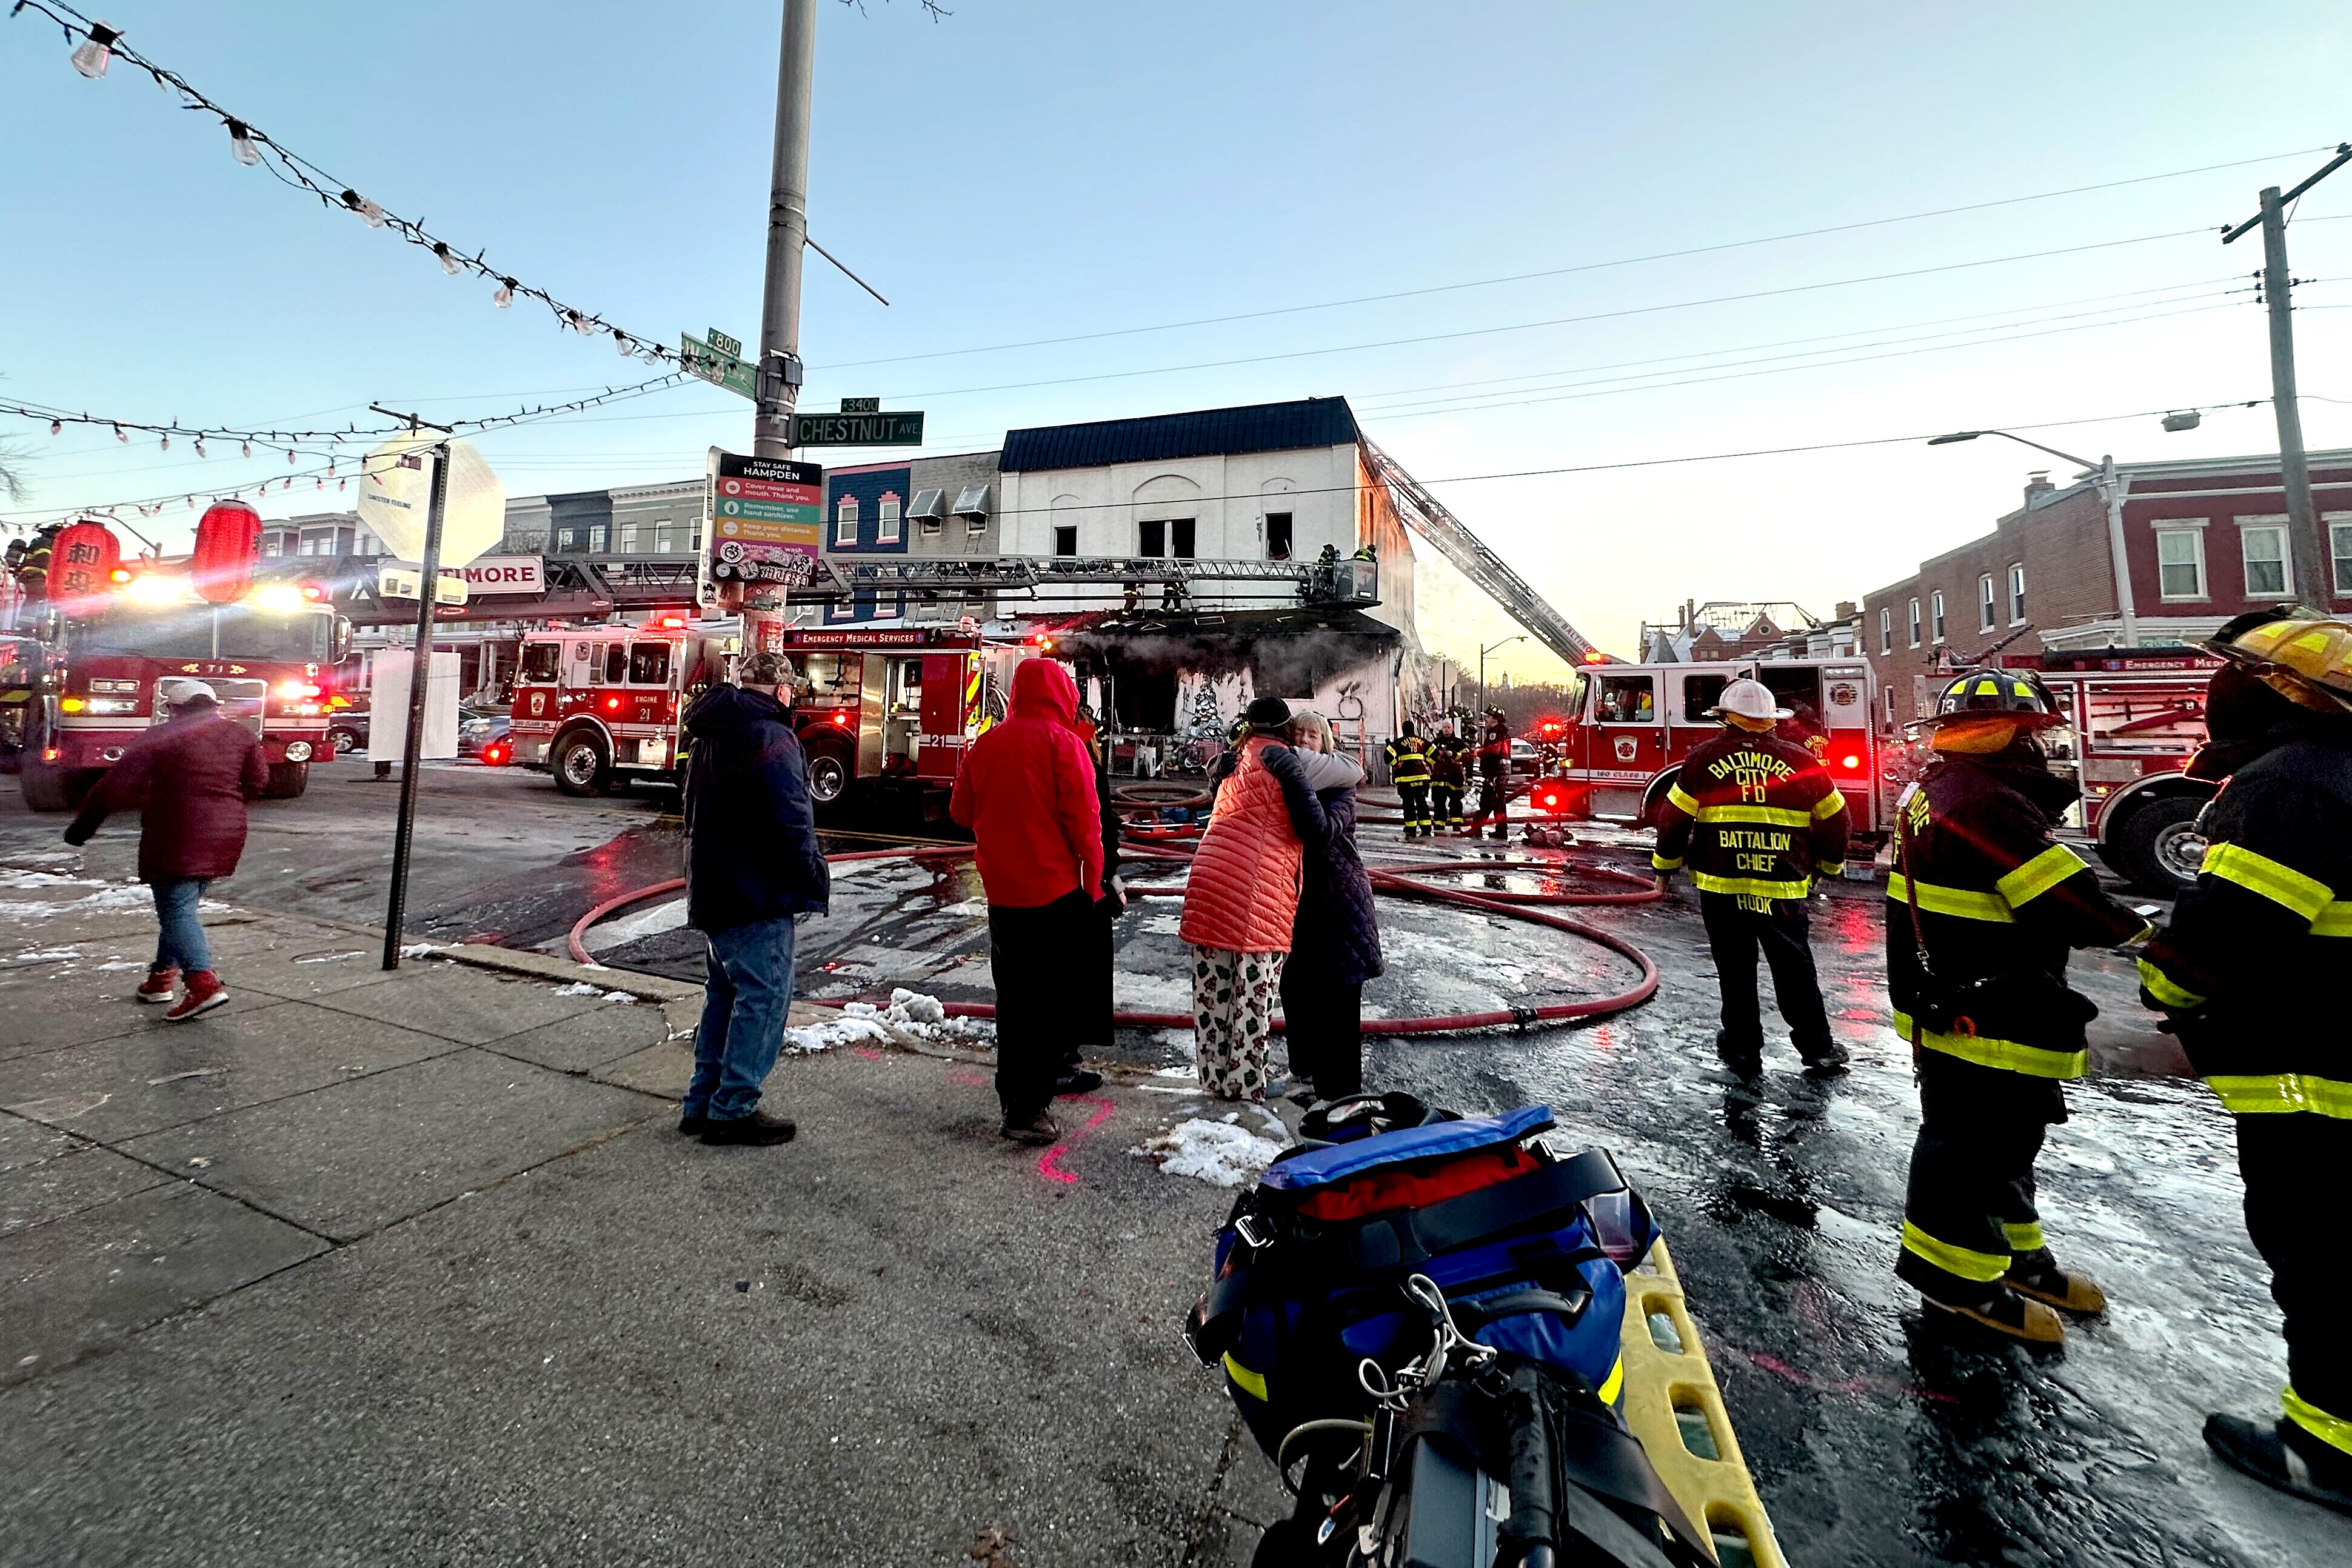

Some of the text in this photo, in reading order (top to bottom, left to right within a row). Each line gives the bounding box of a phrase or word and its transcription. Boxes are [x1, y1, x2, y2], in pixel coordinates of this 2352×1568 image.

[716, 333, 739, 355] 800
[848, 399, 878, 412] 3400
[800, 418, 897, 441] CHESTNUT
[744, 467, 800, 481] HAMPDEN
[744, 502, 785, 513] Remember,
[763, 512, 795, 520] sanitizer.
[1535, 598, 1592, 653] CITY OF BALTIMO
[803, 633, 914, 643] EMERGENCY MEDICAL SERVICES
[2125, 659, 2186, 670] EMERGENCY
[640, 708, 650, 719] 21
[1941, 698, 1956, 714] 13
[931, 734, 945, 747] 21
[1708, 751, 1796, 782] BALTIMORE
[1736, 768, 1768, 787] CITY
[1719, 830, 1791, 851] BATTALION
[1736, 853, 1777, 872] CHIEF
[1736, 894, 1773, 916] HOOK
